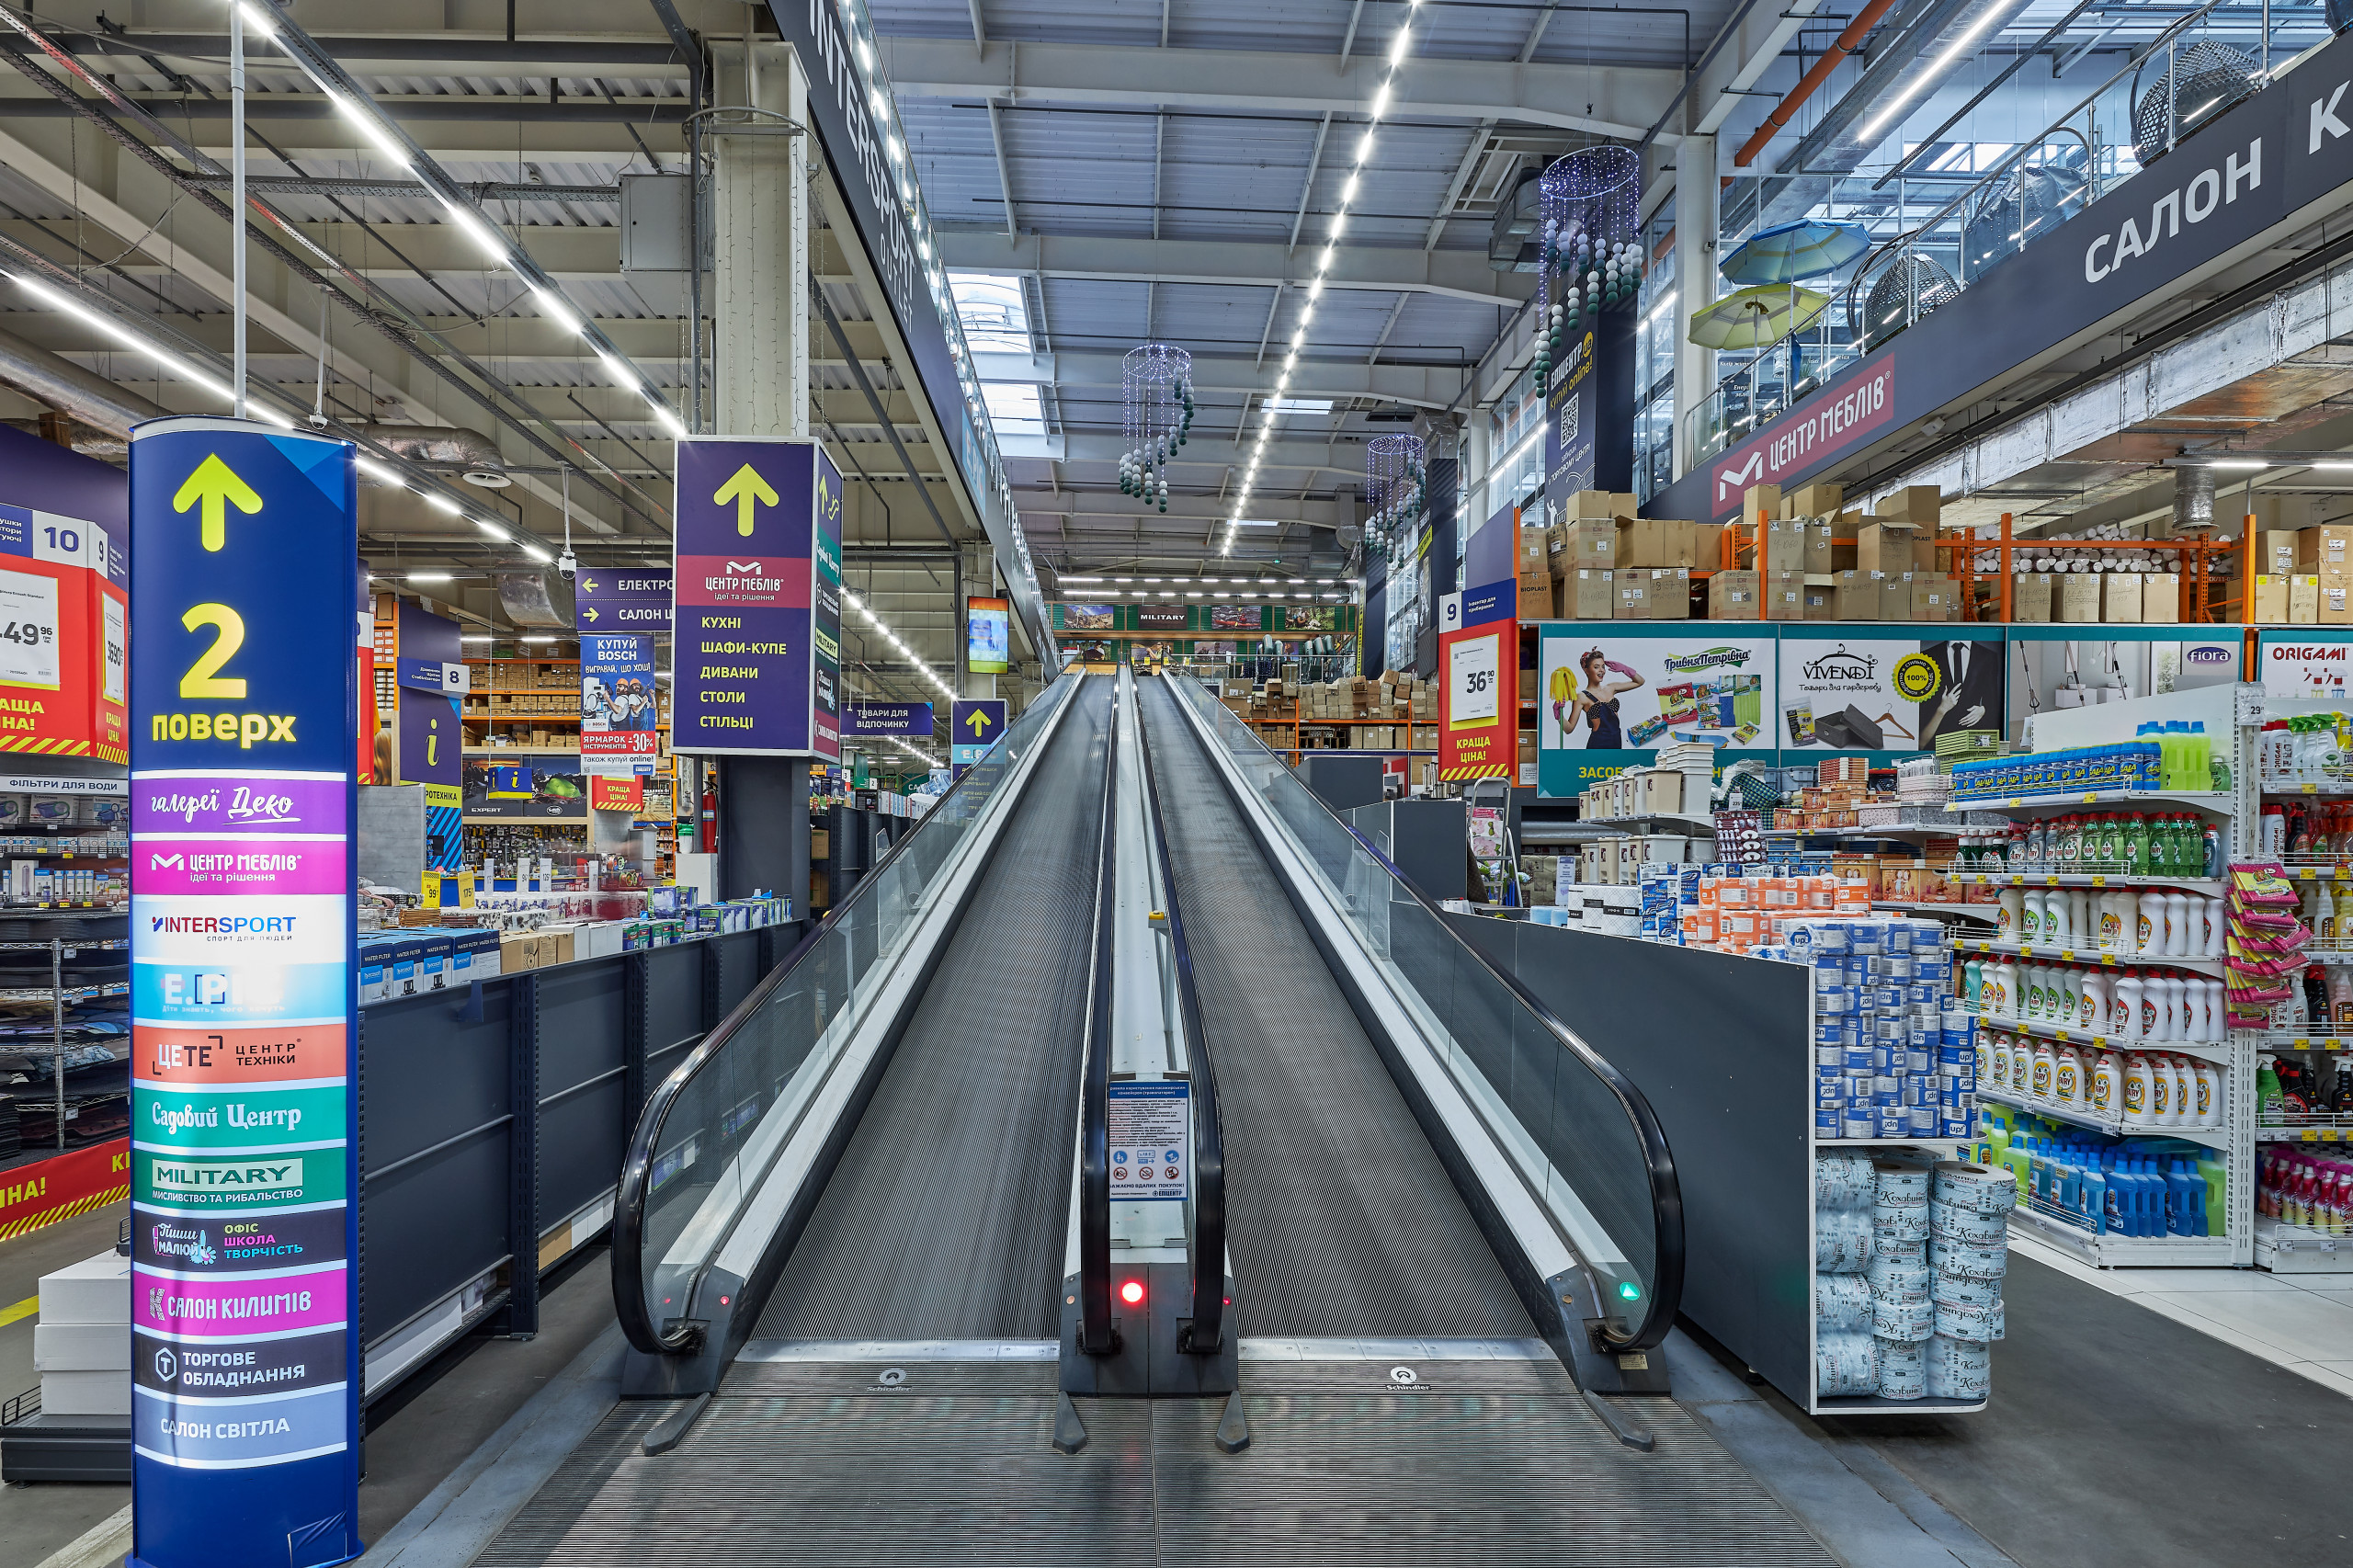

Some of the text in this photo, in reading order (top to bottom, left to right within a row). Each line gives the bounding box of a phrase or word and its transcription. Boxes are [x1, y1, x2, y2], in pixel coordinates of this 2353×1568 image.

[2085, 137, 2261, 283] САЛОН
[880, 233, 913, 334] OUTLET
[1569, 355, 1593, 391] online!
[1769, 375, 1884, 472] ЦЕНТР МЕБЛІВ
[43, 527, 79, 552] 10
[98, 540, 104, 562] 9
[705, 576, 780, 591] ЦЕНТР МЕБЛІВ
[714, 592, 729, 602] ідеї
[742, 593, 775, 602] рішення
[619, 608, 662, 620] САЛОН
[1140, 613, 1185, 621] MILITARY
[1447, 603, 1457, 621] 9
[701, 617, 742, 629] КУХНІ
[0, 621, 40, 646] 49
[40, 626, 52, 635] 96
[179, 602, 247, 699] 2
[597, 637, 638, 650] КУПУЙ
[701, 641, 787, 655] ШАФИ-КУПЕ
[597, 651, 637, 661] BOSCH
[2190, 649, 2229, 662] fiora
[2272, 647, 2346, 661] ORIGAMI
[449, 670, 460, 684] 8
[700, 666, 758, 680] ДИВАНИ
[1803, 665, 1875, 680] VIVENDI
[1466, 671, 1487, 694] 36
[1799, 682, 1881, 693] Товари для гардеробу
[699, 691, 745, 703] СТОЛИ
[857, 710, 908, 719] ТОВАРИ ДЛЯ
[2250, 705, 2261, 715] 29
[0, 716, 35, 731] НА!
[106, 711, 121, 729] КРАЩА
[699, 716, 754, 730] СТІЛЬЦІ
[857, 721, 909, 729] ВІДПОЧИНКУ
[108, 729, 120, 744] ЦІНА!
[152, 712, 298, 749] поверх
[583, 735, 626, 744] ЯРМАРОК
[1456, 736, 1491, 749] КРАЩА
[607, 755, 628, 764] купуй
[1460, 750, 1486, 764] ЦІНА!
[9, 779, 118, 791] ФІЛЬТРИ ДЛЯ ВОДИ
[607, 785, 631, 794] КРАЩА
[609, 793, 628, 801] ЦІНА!
[151, 786, 294, 824] галереї Деко
[189, 854, 297, 872] ЦЕНТР МЕБЛІВ
[189, 872, 208, 882] ідеї
[226, 872, 276, 883] рішення
[428, 889, 437, 898] 99
[165, 916, 297, 933] INTERSPORT
[158, 1043, 212, 1070] ЦЕТЕ
[235, 1043, 296, 1056] ЦЕНТР
[235, 1054, 296, 1066] ТЕХНІКИ
[1960, 1052, 1972, 1062] up!
[152, 1101, 301, 1135] Садовий Центр
[1949, 1124, 1966, 1134] up!
[157, 1165, 292, 1185] MILITARY
[152, 1188, 303, 1203] МИСЛИВСТВО ТА РИБАЛЬСТВО
[1881, 1190, 1927, 1206] Кохавинка
[223, 1223, 259, 1234] ОФІС
[223, 1234, 276, 1247] ШКОЛА
[1875, 1241, 1920, 1254] Кохавинка
[158, 1240, 199, 1256] МАЛЮЙ
[223, 1244, 303, 1259] ТВОРЧІСТЬ
[167, 1290, 312, 1320] САЛОН КИЛИМІВ
[183, 1351, 256, 1368] ТОРГОВЕ
[183, 1364, 305, 1388] ОБЛАДНАННЯ
[160, 1417, 290, 1439] САЛОН СВІТЛА
